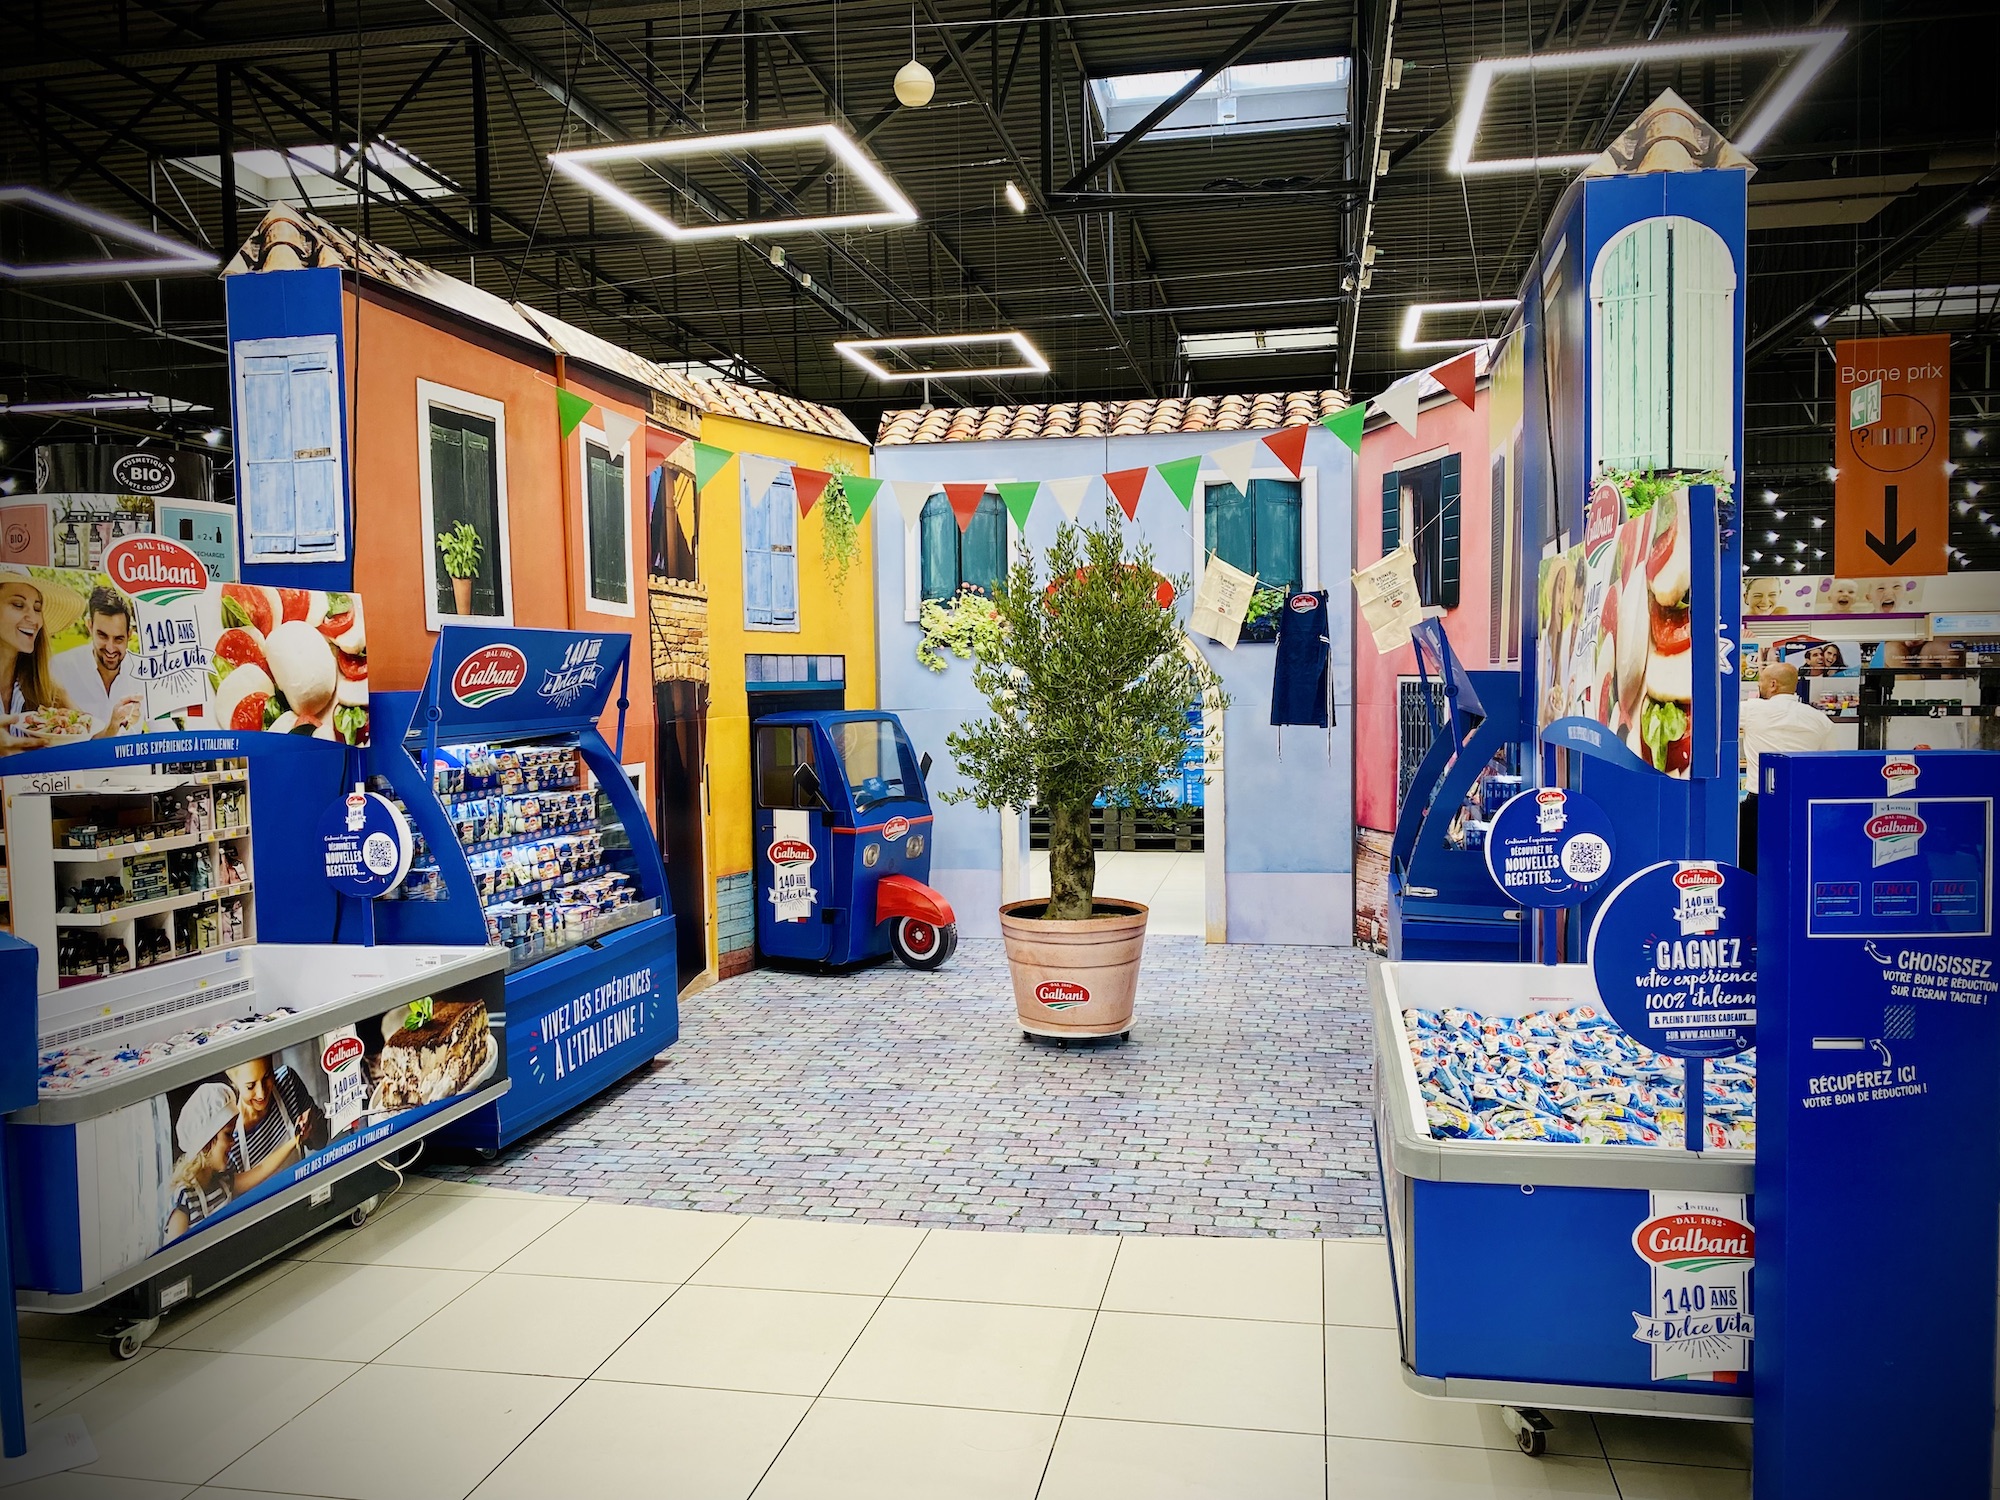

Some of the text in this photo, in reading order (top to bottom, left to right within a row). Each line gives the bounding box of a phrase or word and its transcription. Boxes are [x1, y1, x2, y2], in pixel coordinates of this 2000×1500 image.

[1841, 362, 1943, 384] Borne prix
[130, 467, 162, 482] BIO
[10, 533, 23, 544] BIO
[203, 533, 208, 541] 2
[117, 552, 200, 585] Galbani
[145, 619, 196, 650] 140 ANS
[137, 645, 208, 678] de Dolce Vita
[560, 638, 602, 670] 140 ANS
[460, 661, 520, 688] Galbani
[552, 667, 579, 694] Dolce
[115, 743, 134, 758] VIVEZ
[136, 742, 149, 756] DES
[150, 739, 193, 754] EXPÉRIENCES
[194, 737, 199, 751] À
[200, 738, 234, 751] L'ITALIENNE
[1885, 766, 1916, 776] Galbani
[32, 776, 70, 792] Soleil
[1871, 820, 1919, 835] Galbani
[773, 845, 810, 860] Galbani
[1510, 845, 1554, 856] DÉCOUVREZ DE
[1505, 854, 1560, 872] NOUVELLES
[779, 873, 806, 889] 140 ANS
[1504, 870, 1562, 887] RECETTES...
[1679, 873, 1718, 885] Galbani
[1685, 896, 1701, 909] 140
[1657, 938, 1742, 971] GAGNEZ
[1897, 949, 1993, 978] CHOISISSEZ
[1635, 967, 1757, 996] votre expérience
[1882, 969, 1999, 992] VOTRE BON DE RÉDUCTION
[1039, 986, 1084, 1001] Galbani
[1645, 983, 1757, 1010] 100% italienn
[1890, 984, 1988, 1005] SUR L'ÉCRAN TACTILE !
[540, 967, 651, 1044] VIVEZ DES EXPÉRIENCES
[1654, 1016, 1660, 1025] &
[1662, 1015, 1684, 1025] PLEINS
[1686, 1013, 1716, 1024] D'AUTRES
[554, 1002, 644, 1081] À L'ITALIENNE !
[1665, 1028, 1737, 1040] SUR WWW.GALBANI.FR
[326, 1041, 359, 1067] Galbani
[333, 1076, 348, 1098] 140
[1808, 1065, 1917, 1095] RÉCUPÉREZ ICI
[1802, 1082, 1928, 1109] VOTRE BON DE RÉDUCTION !
[294, 1165, 311, 1181] VIVEZ
[311, 1158, 322, 1172] DES
[322, 1140, 357, 1166] EXPÉRIENCES
[356, 1135, 361, 1149] À
[361, 1127, 390, 1147] L'ITALIENNE
[1648, 1227, 1749, 1255] Galbani
[1662, 1285, 1738, 1316] 140 ANS
[1646, 1312, 1753, 1341] de Dolce Vita
